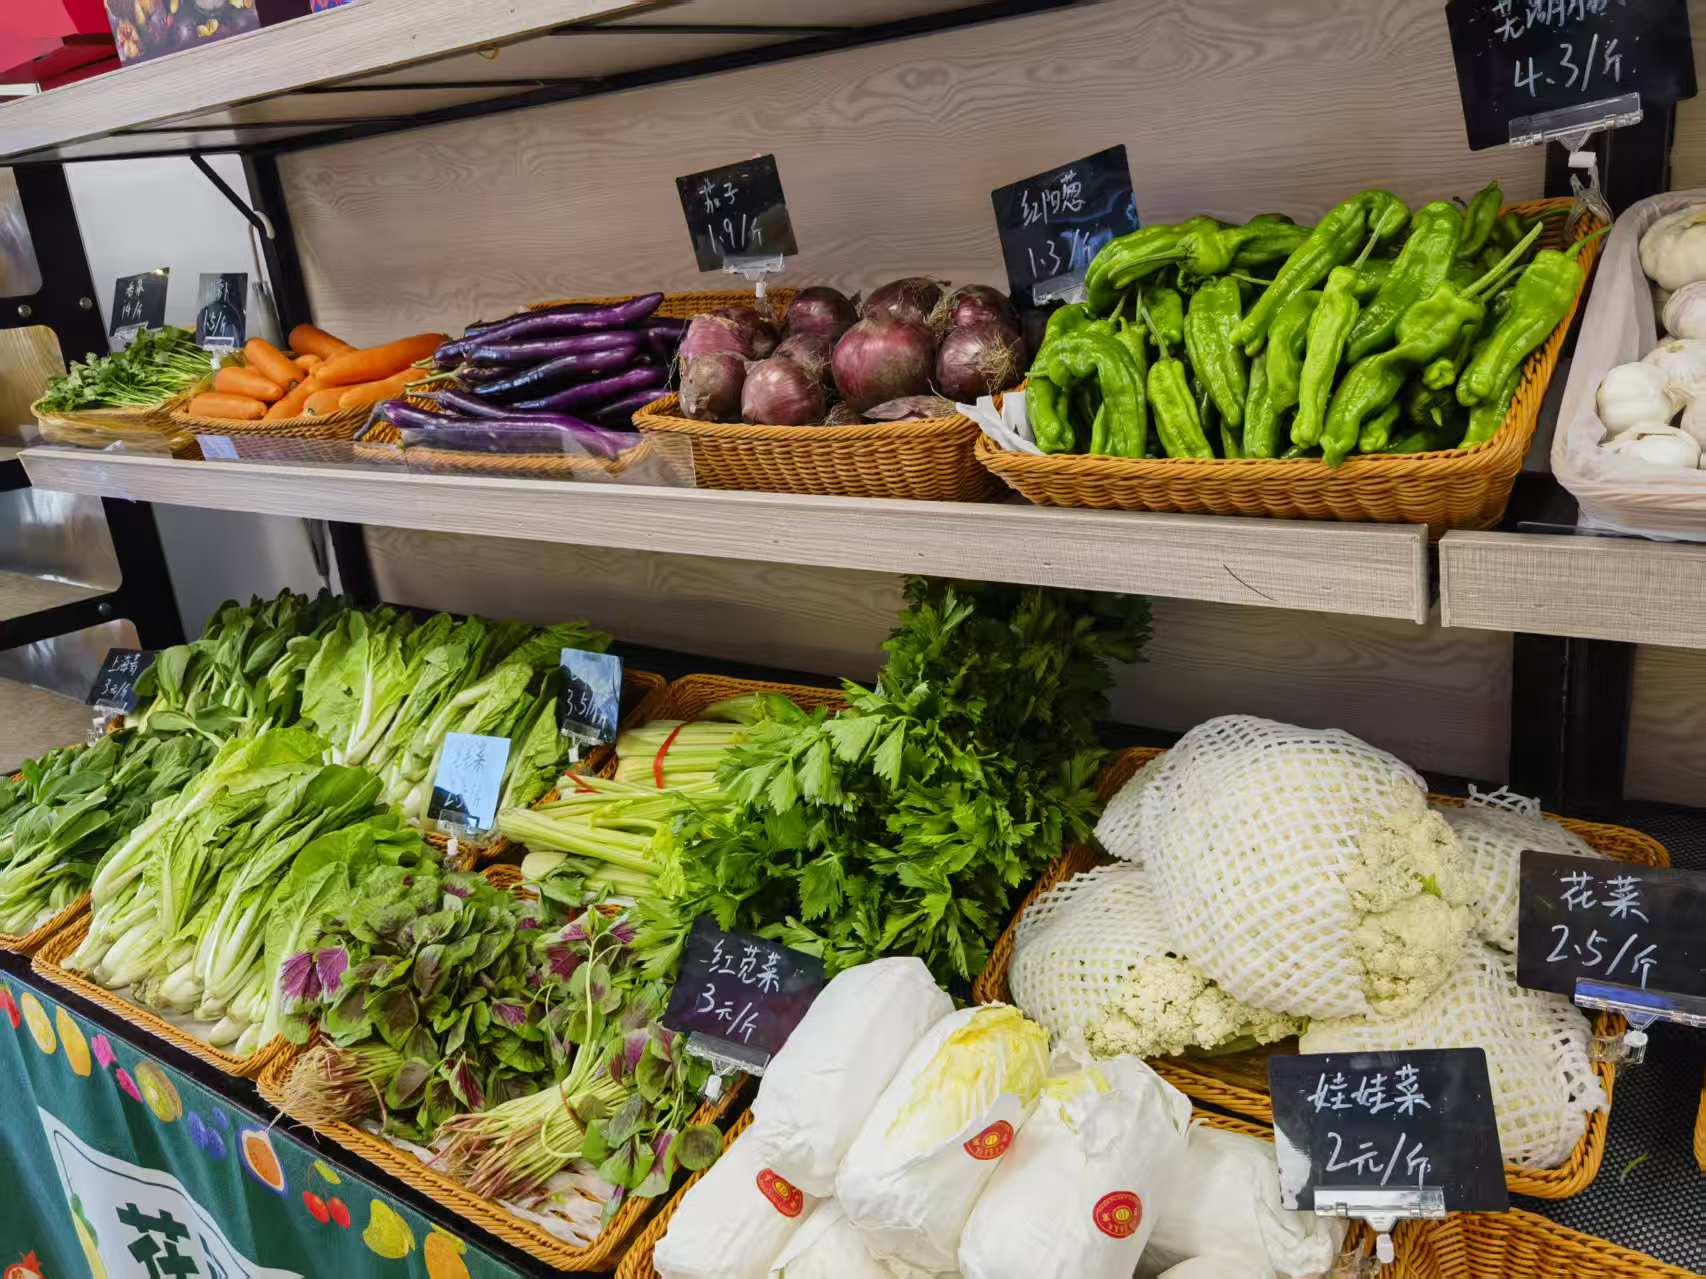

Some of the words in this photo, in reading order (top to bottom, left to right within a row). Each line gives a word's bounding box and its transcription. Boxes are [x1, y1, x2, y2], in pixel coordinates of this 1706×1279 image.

[699, 176, 739, 214] 茄子
[1560, 871, 1649, 923] 花菜
[708, 938, 781, 994] 红苋菜
[696, 983, 760, 1044] 3元/斤
[1307, 1063, 1431, 1116] 娃娃菜
[1325, 1132, 1432, 1190] 2元/斤
